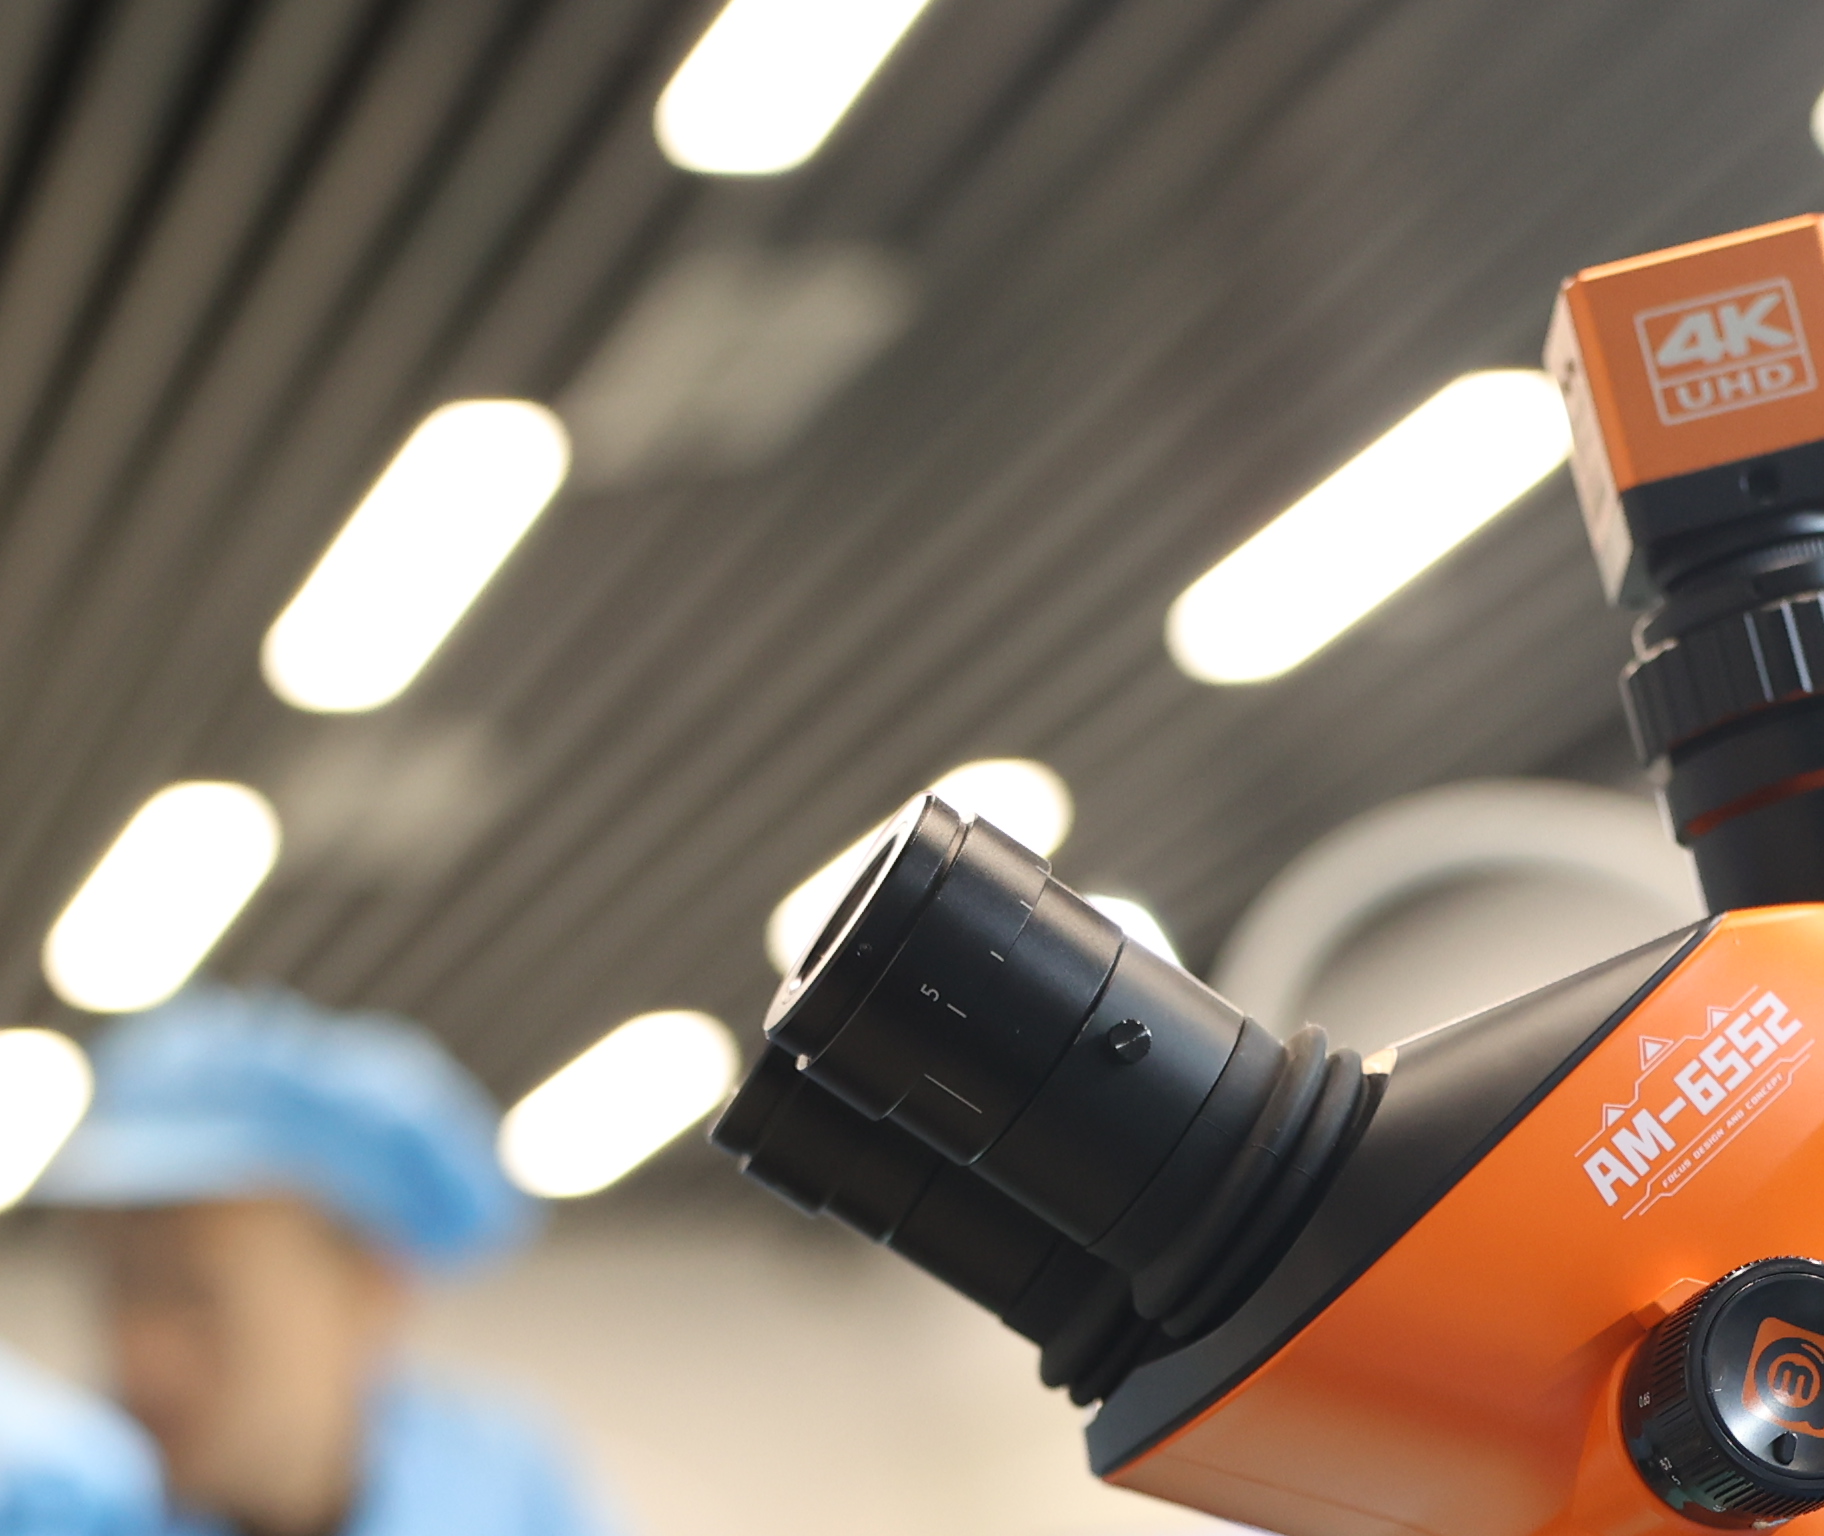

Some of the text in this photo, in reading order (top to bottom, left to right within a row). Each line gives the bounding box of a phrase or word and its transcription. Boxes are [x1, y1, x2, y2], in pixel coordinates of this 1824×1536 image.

[1656, 292, 1794, 370] 4K
[1676, 361, 1796, 411] UHD
[919, 983, 941, 1003] 5
[1582, 990, 1804, 1207] AM-6552
[1662, 1072, 1784, 1189] FOCUS DESIGN AND CONCEPT
